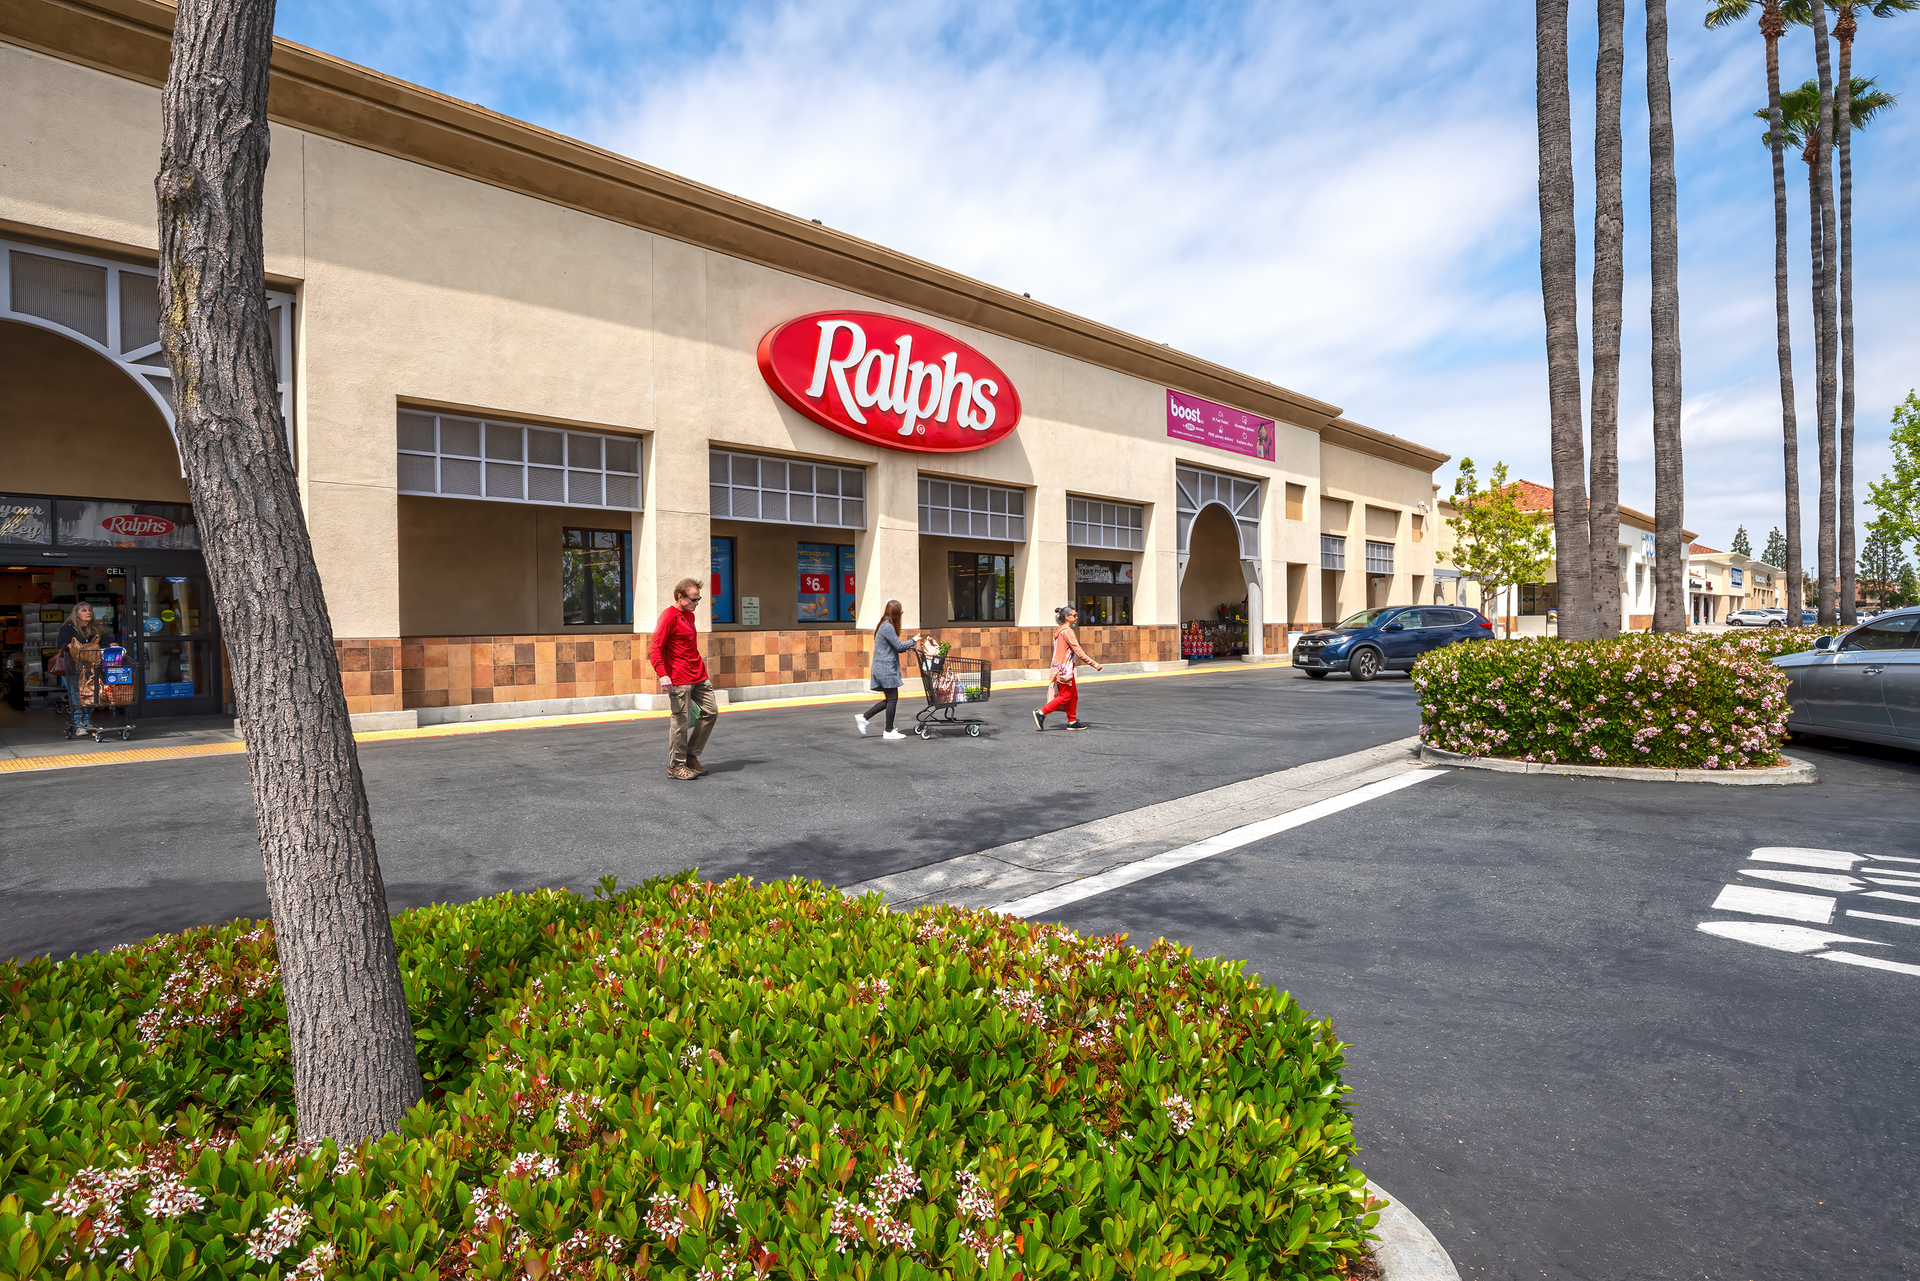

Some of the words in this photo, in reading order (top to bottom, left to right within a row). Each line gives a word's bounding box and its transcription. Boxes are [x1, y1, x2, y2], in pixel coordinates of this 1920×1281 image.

[806, 320, 998, 435] Ralphs
[109, 516, 166, 536] Ralphs
[806, 577, 820, 591] $6
